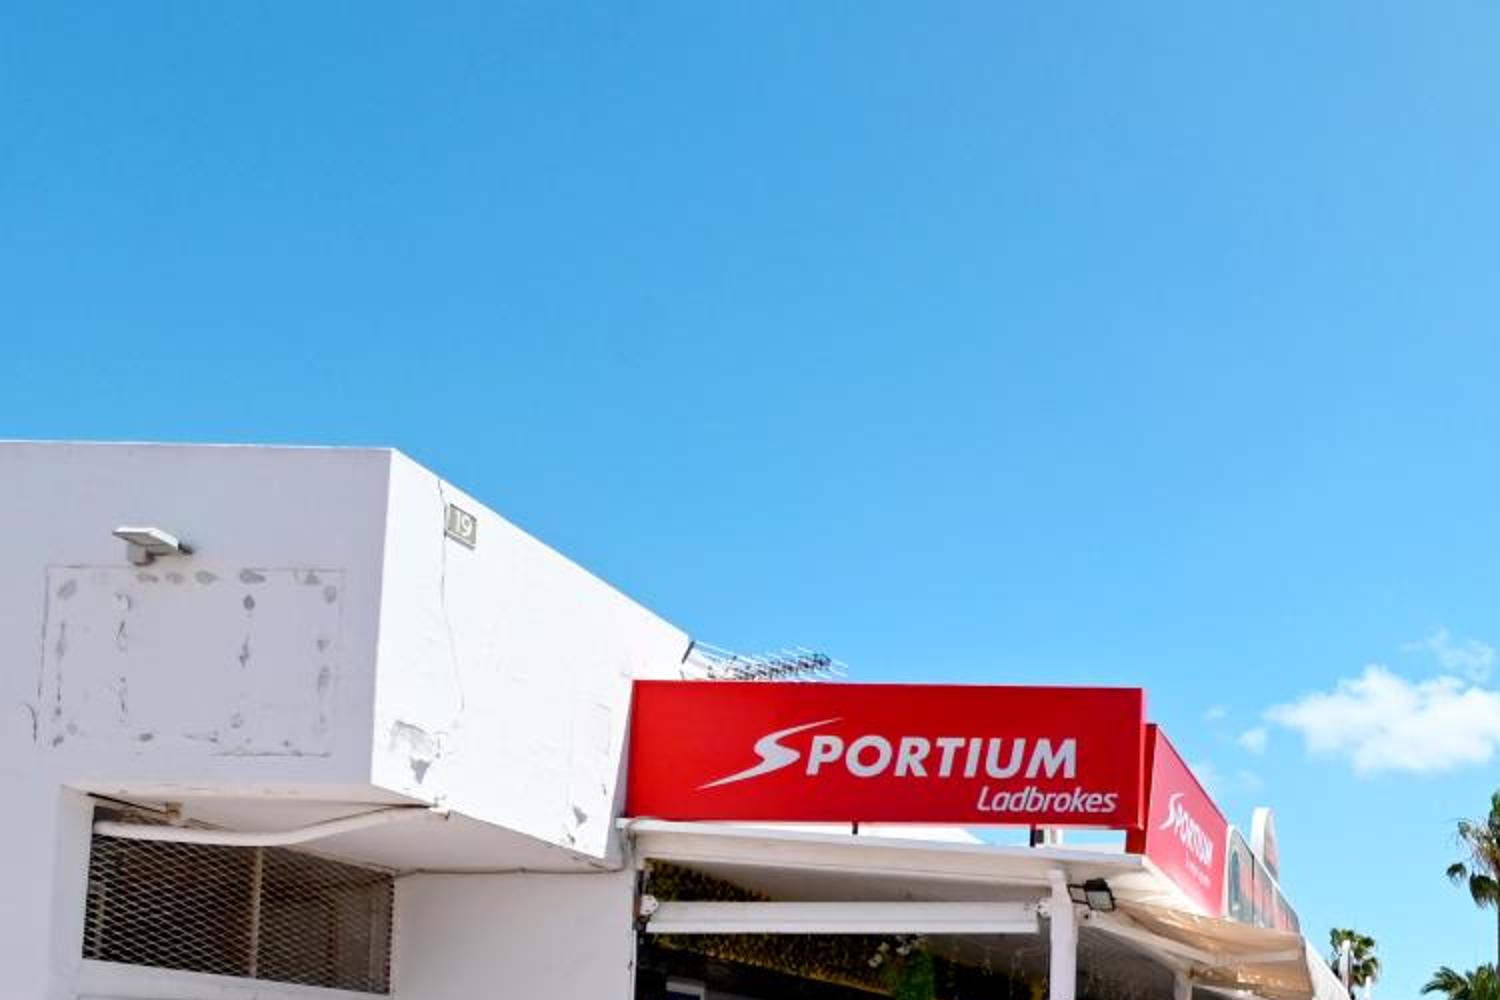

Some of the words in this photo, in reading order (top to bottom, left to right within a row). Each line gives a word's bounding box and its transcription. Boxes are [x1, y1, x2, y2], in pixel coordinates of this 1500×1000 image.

[456, 510, 473, 537] 19
[697, 717, 1077, 790] SPORTIUM
[976, 785, 1118, 814] Ladbrokes
